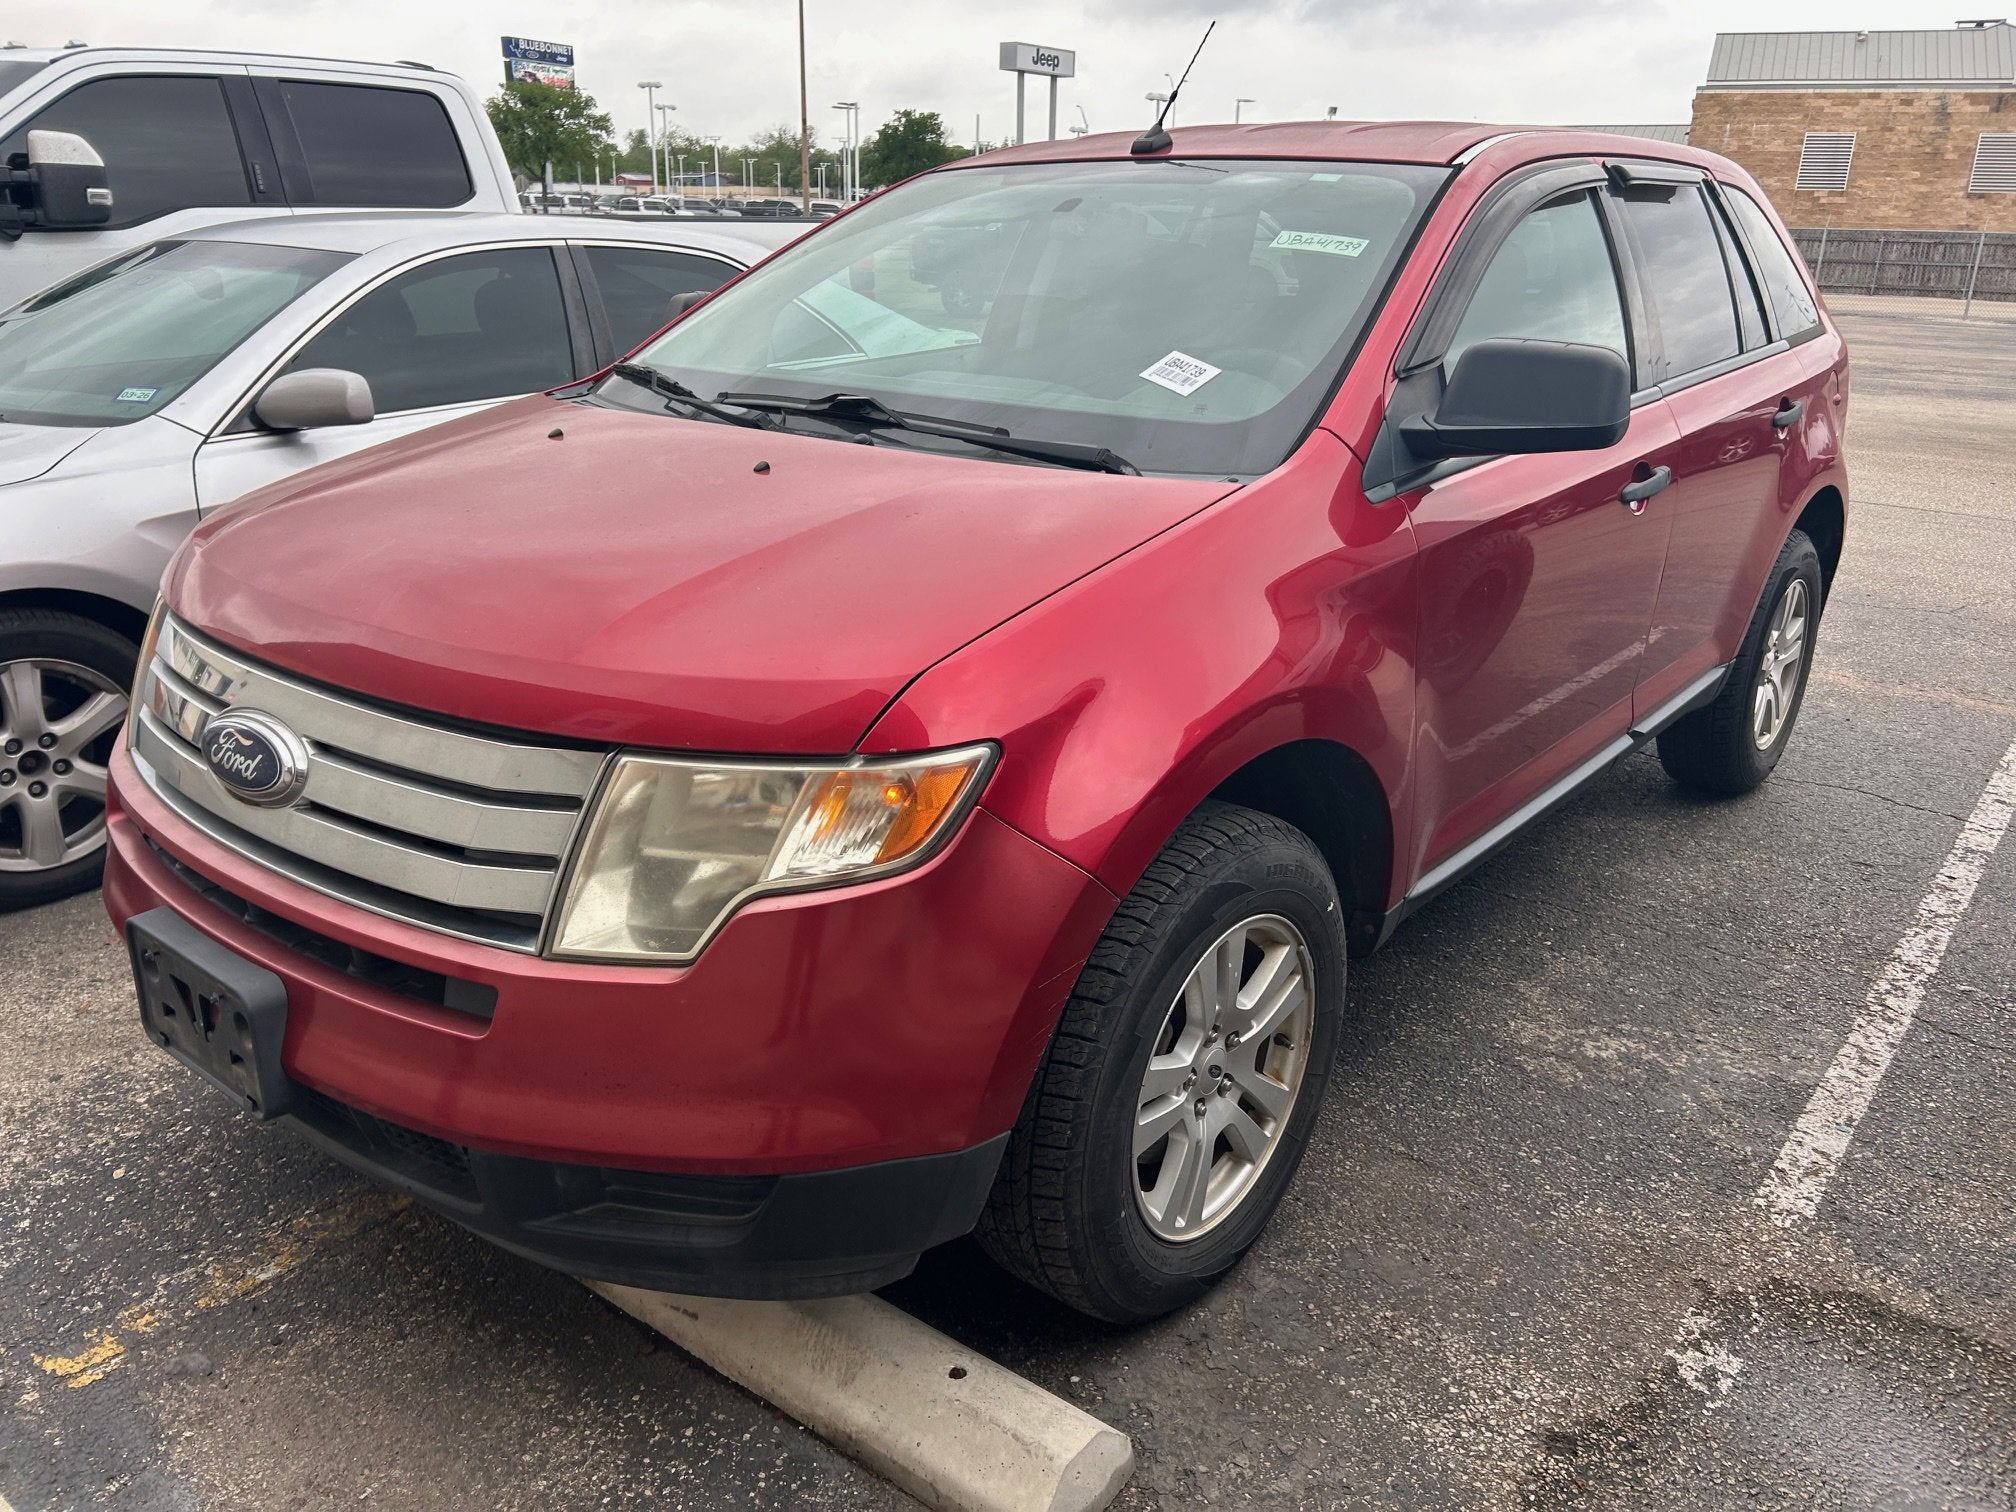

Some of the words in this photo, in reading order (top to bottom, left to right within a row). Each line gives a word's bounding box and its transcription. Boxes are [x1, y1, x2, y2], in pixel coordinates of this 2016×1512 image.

[519, 39, 572, 56] BLUEBONNET
[1032, 48, 1059, 71] Jeep
[1277, 234, 1361, 251] UBA41739
[211, 728, 264, 780] Ford
